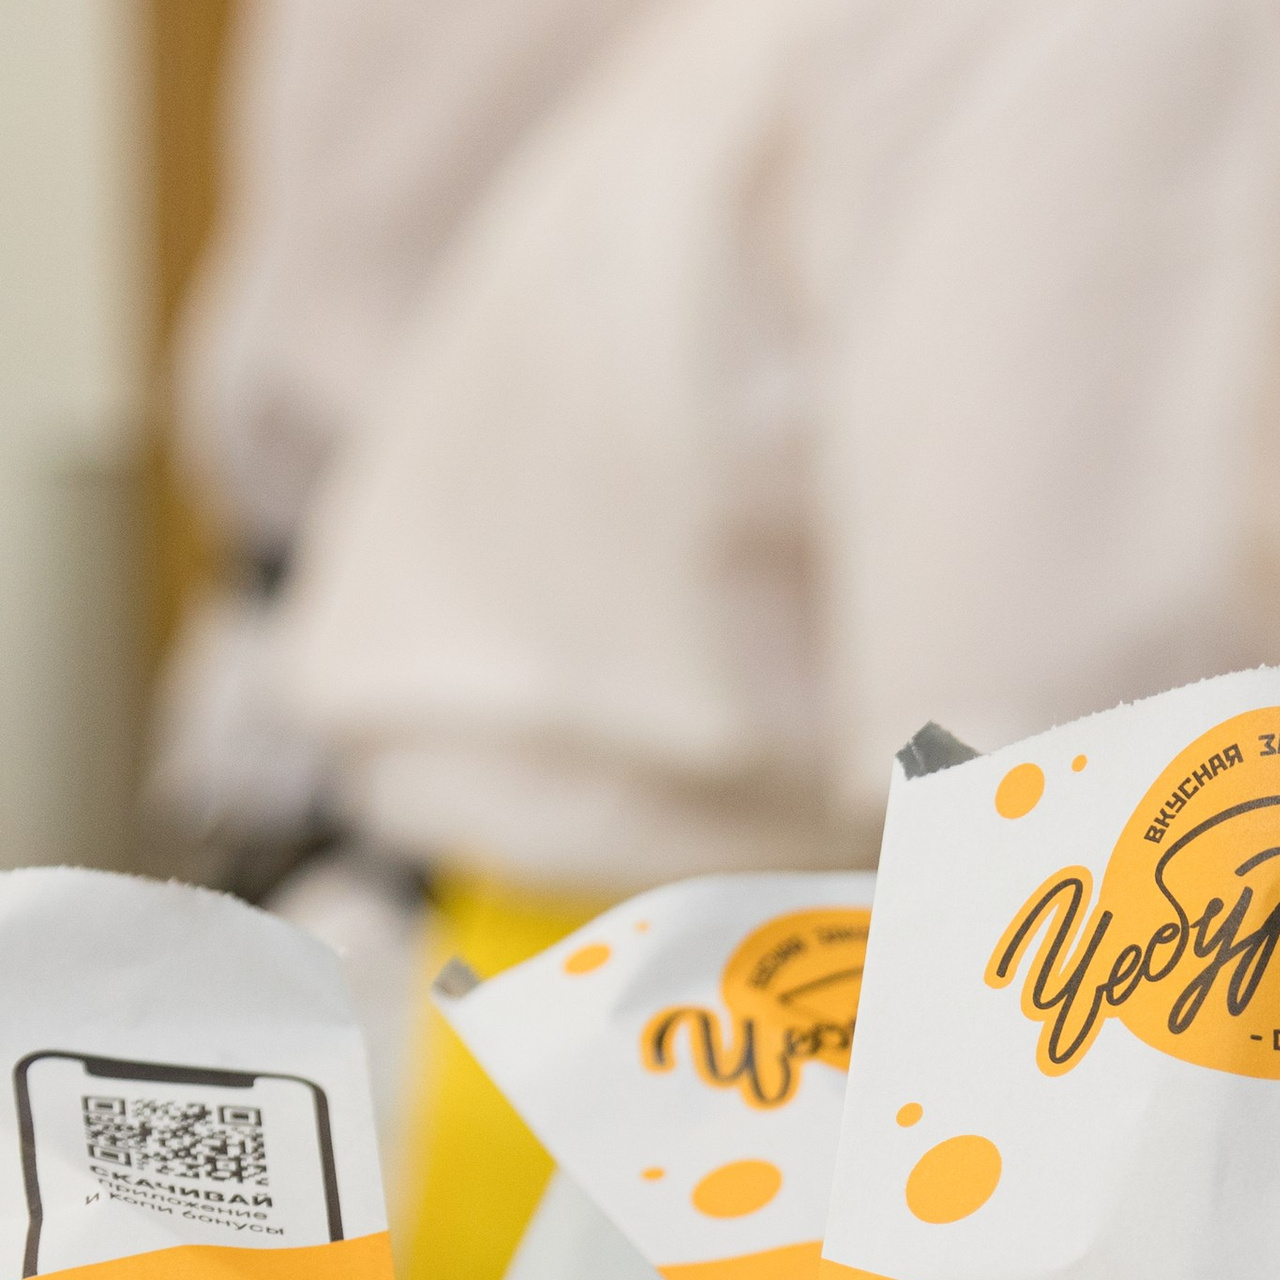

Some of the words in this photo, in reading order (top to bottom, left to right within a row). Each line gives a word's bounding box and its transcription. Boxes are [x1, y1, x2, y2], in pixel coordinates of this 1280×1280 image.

[1143, 743, 1244, 844] ВКУСНАЯ
[89, 1165, 273, 1208] СКАЧИВАЙ
[97, 1178, 268, 1220] приложение
[109, 1192, 173, 1214] копи
[182, 1210, 284, 1235] бонусы
